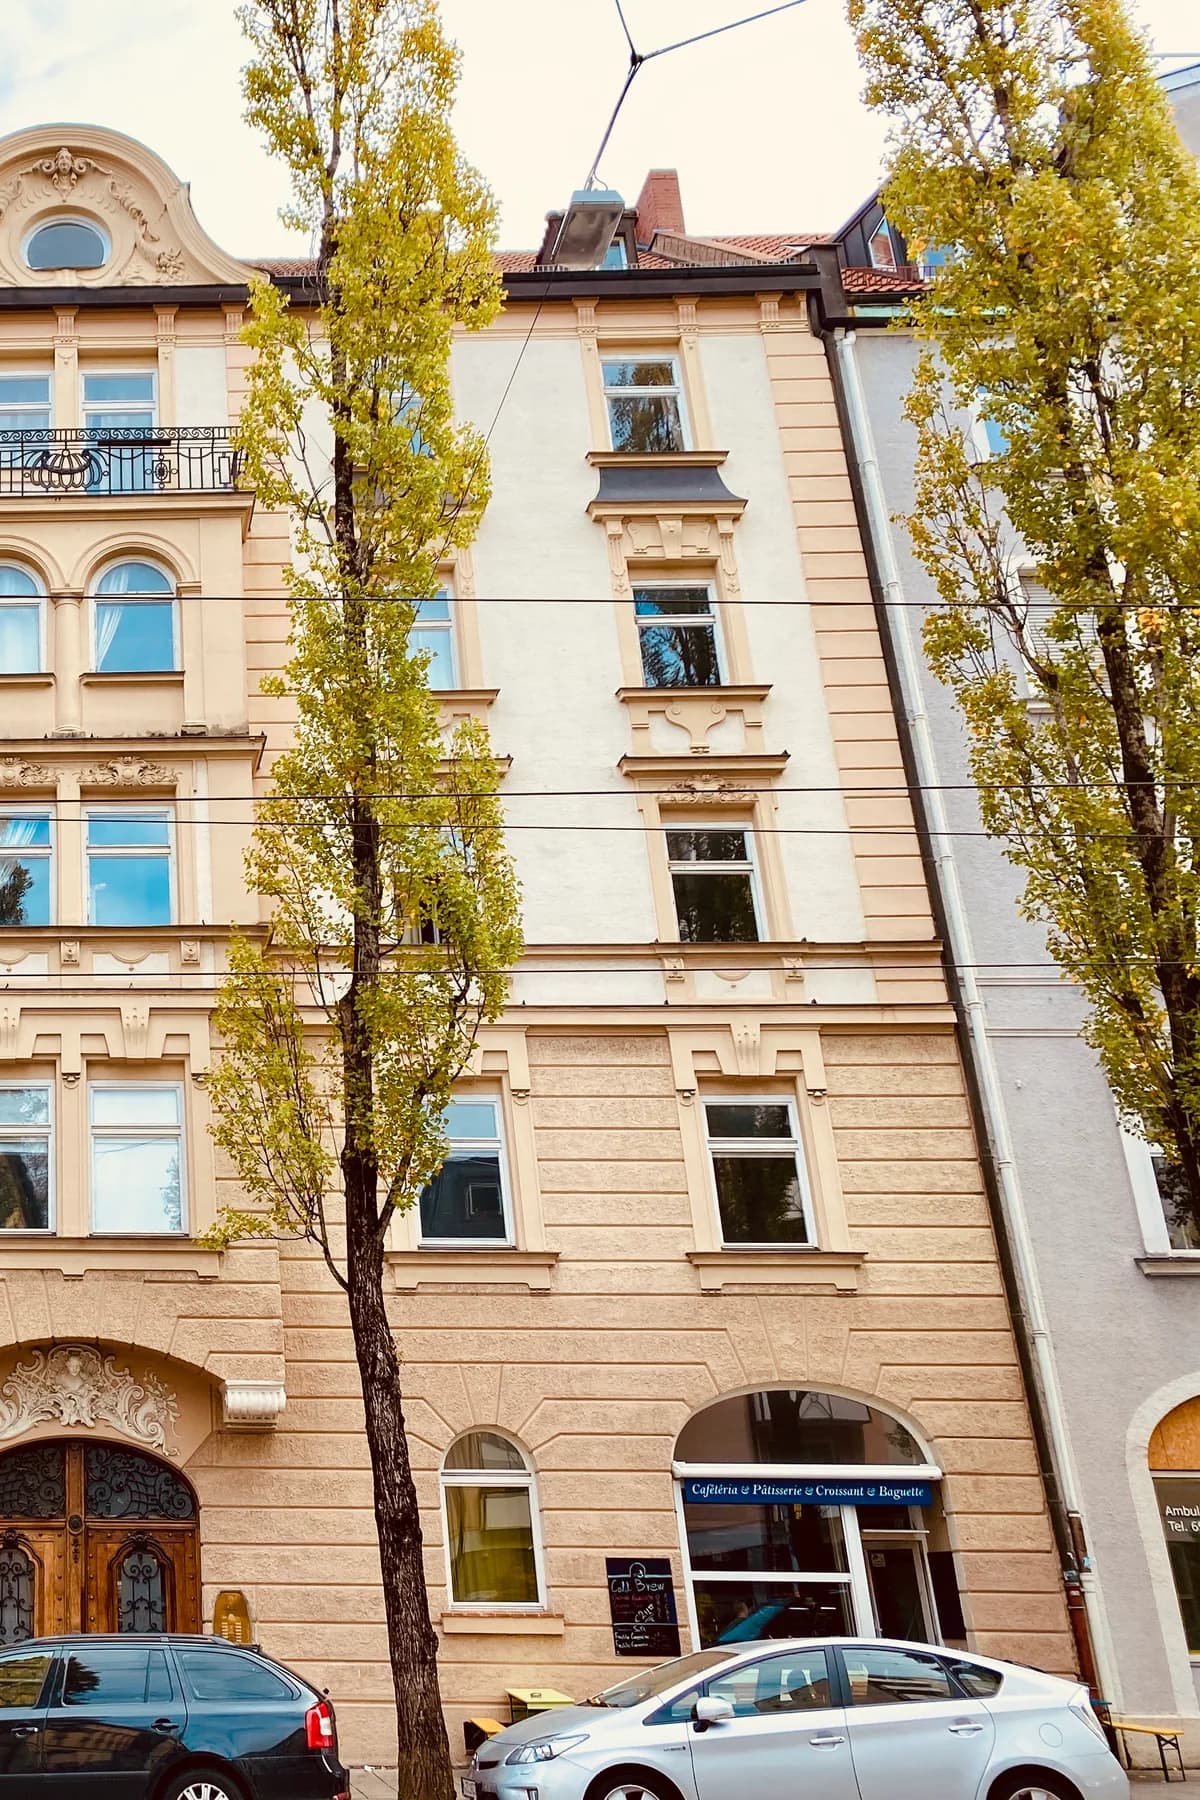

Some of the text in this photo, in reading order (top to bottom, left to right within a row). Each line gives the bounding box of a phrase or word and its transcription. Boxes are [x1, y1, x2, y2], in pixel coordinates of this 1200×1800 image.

[752, 1483, 802, 1496] Pâtisserie
[815, 1484, 864, 1497] Croissant
[879, 1485, 924, 1501] Baguette
[1166, 1505, 1200, 1516] Ambul
[1168, 1521, 1188, 1531] Tel.
[634, 1578, 665, 1592] Brew
